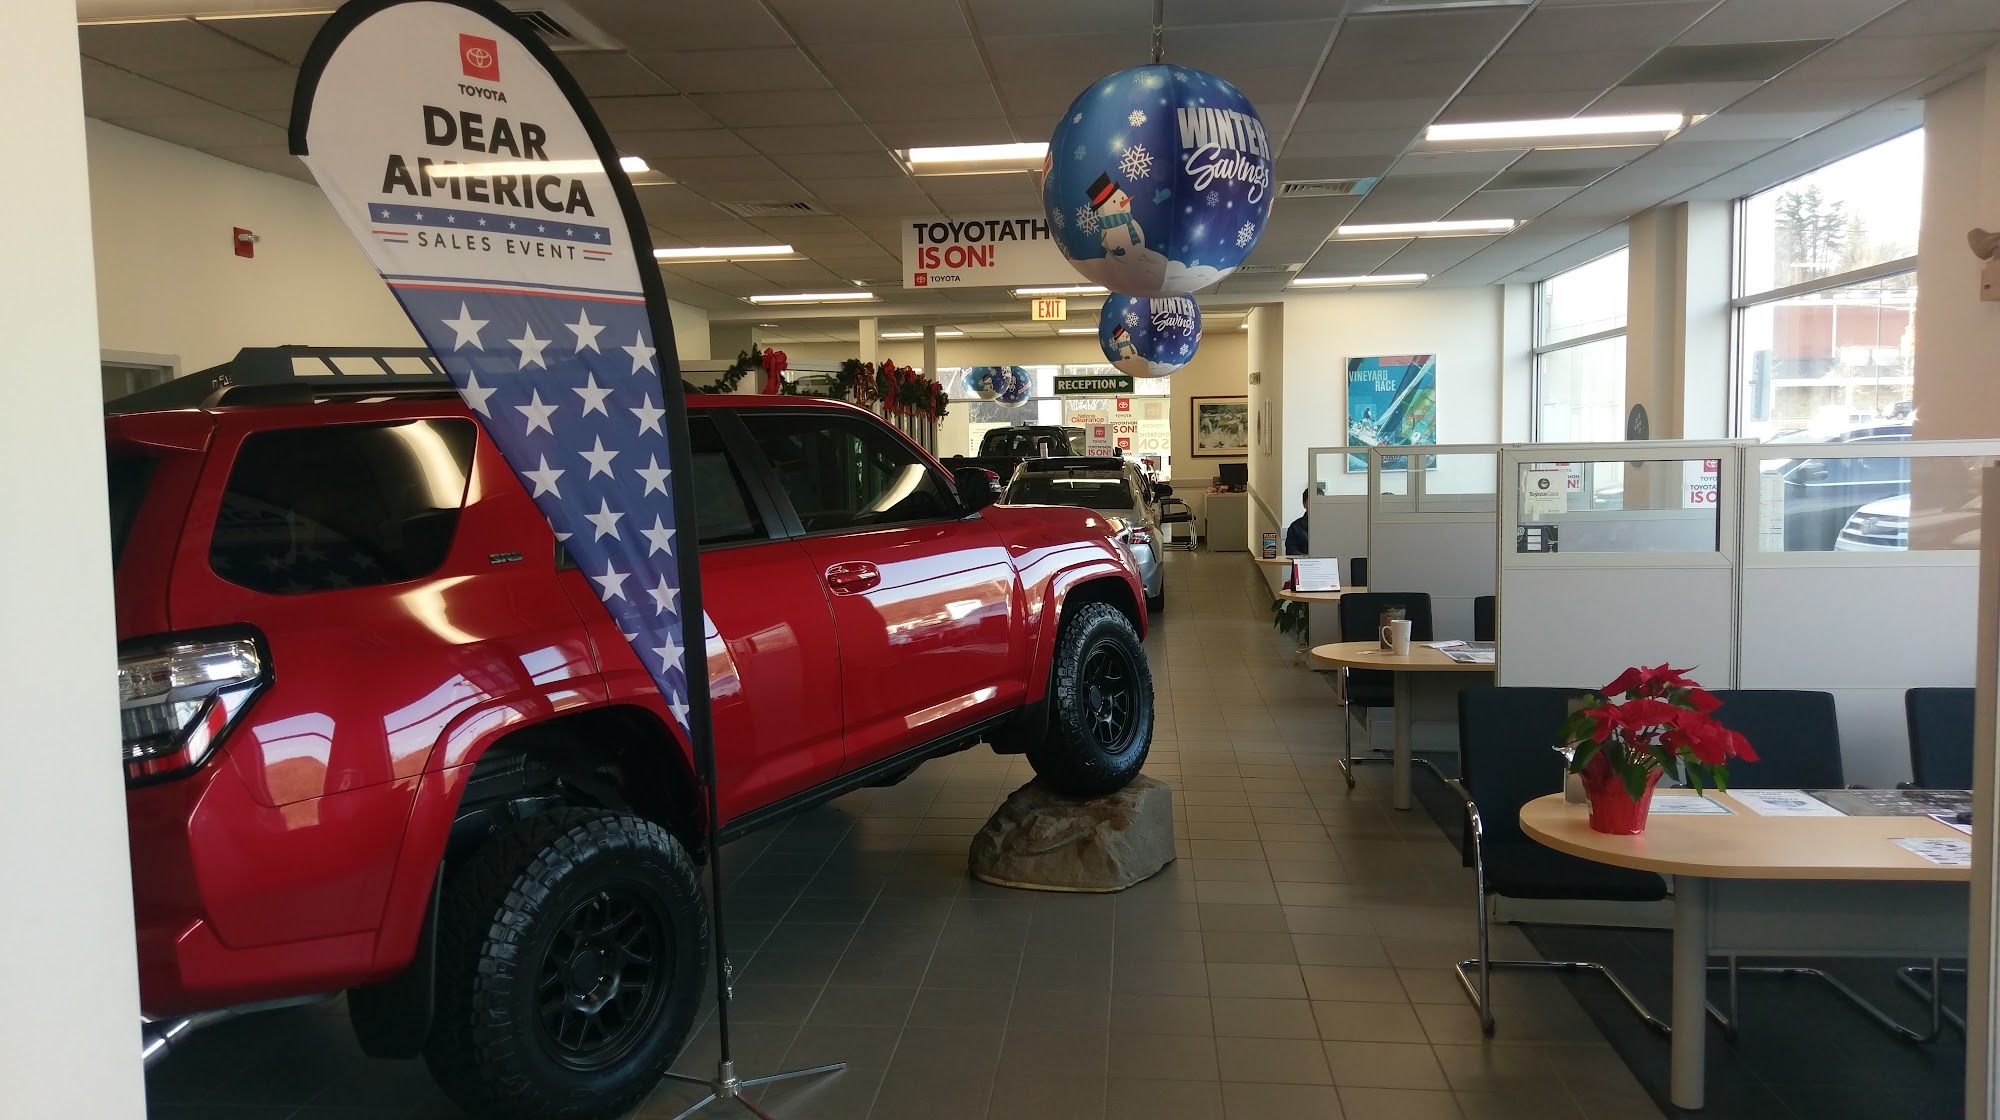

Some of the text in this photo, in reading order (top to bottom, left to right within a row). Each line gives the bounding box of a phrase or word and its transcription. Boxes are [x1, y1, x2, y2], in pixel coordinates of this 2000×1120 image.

[458, 83, 507, 103] TOYOTA
[422, 105, 550, 161] DEAR
[1177, 107, 1270, 161] WINTER
[1185, 142, 1270, 204] Savings
[382, 154, 595, 217] AMERICA
[912, 219, 1050, 244] TOYOTATH
[418, 231, 576, 260] SALES EVENT
[918, 245, 995, 269] IS ON!
[1038, 300, 1061, 318] EXIT
[1149, 297, 1195, 318] WINTER
[1152, 311, 1195, 336] Savings
[1058, 379, 1116, 390] RECEPTION
[1349, 370, 1388, 382] VINEYARD
[1375, 380, 1396, 391] RACE
[1120, 426, 1138, 434] ON!
[1567, 479, 1580, 489] N!
[1690, 491, 1704, 503] IS
